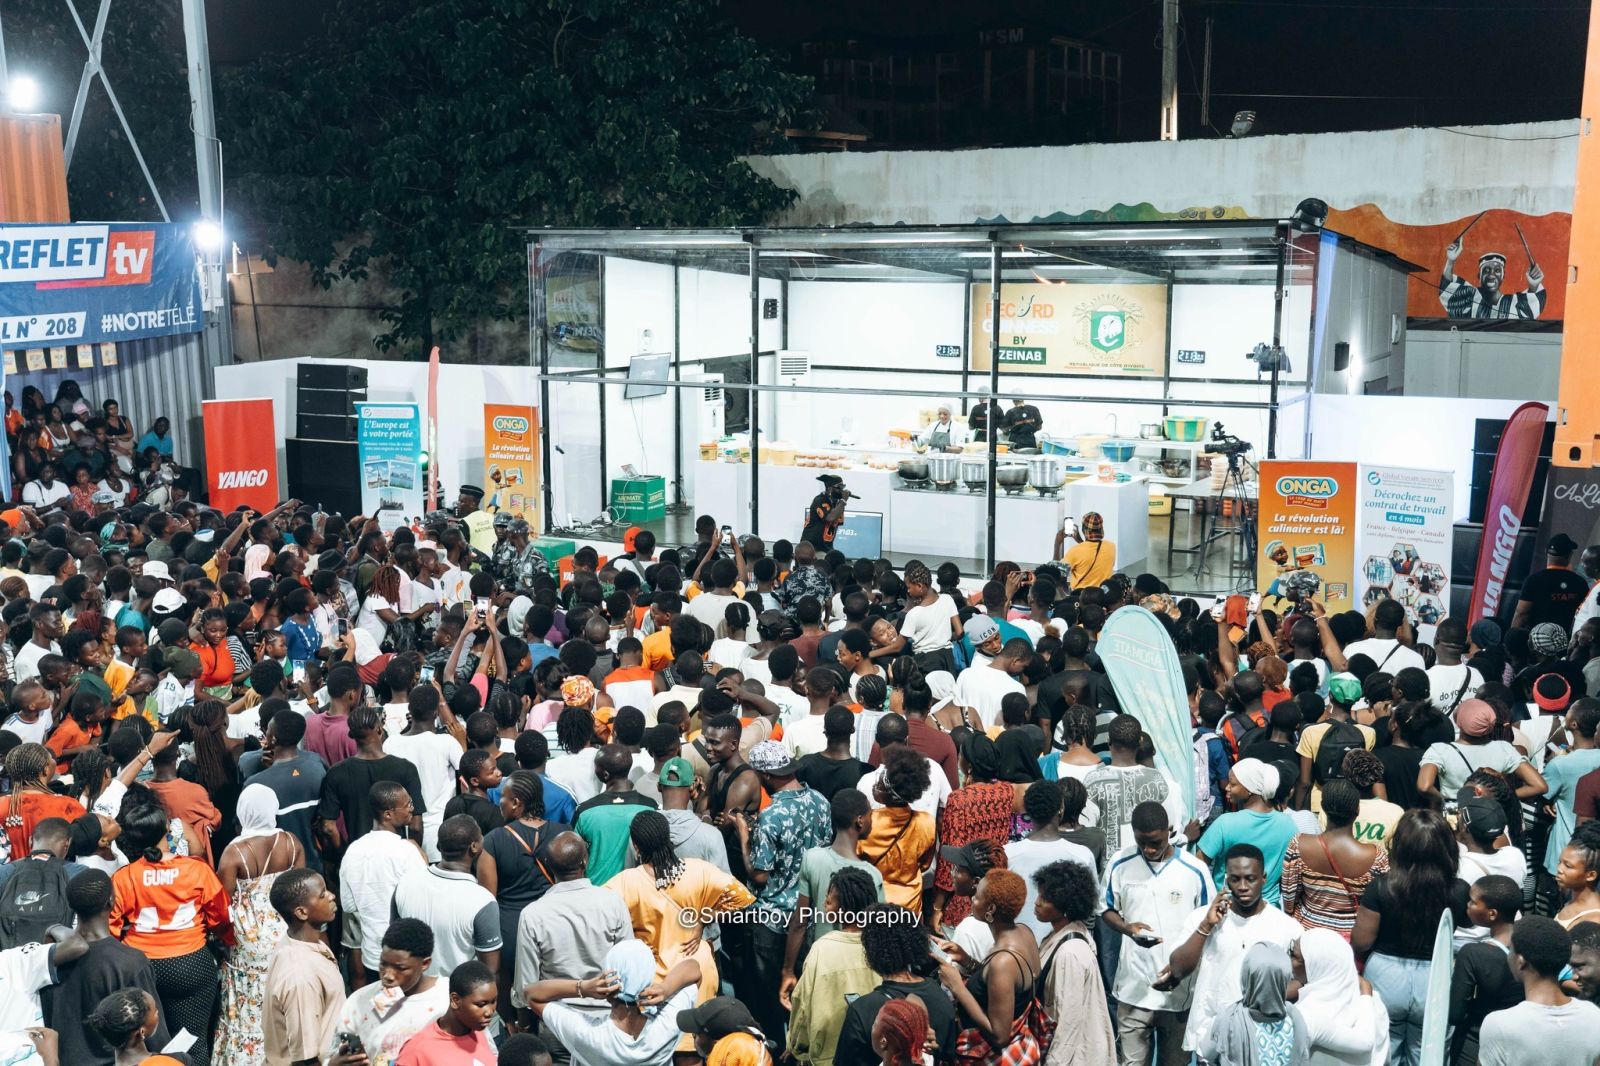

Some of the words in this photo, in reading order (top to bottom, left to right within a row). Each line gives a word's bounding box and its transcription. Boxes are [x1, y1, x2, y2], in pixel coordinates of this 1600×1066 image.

[0, 237, 104, 270] REFLET
[113, 241, 148, 275] tv
[45, 317, 77, 337] 208
[1013, 336, 1027, 345] BY
[998, 349, 1042, 361] ZEINAB
[496, 418, 525, 430] ONGA
[217, 469, 268, 490] YANGO
[1280, 479, 1332, 494] ONGA
[1374, 489, 1421, 502] Décrochez
[1423, 496, 1436, 504] un
[1364, 500, 1397, 510] contrat
[1399, 502, 1411, 511] de
[1413, 506, 1446, 515] travail
[1274, 513, 1286, 522] La
[1288, 513, 1339, 523] révolution
[1404, 516, 1423, 524] mois
[1268, 523, 1311, 533] culinaire
[1314, 525, 1328, 534] est
[1482, 504, 1521, 617] YANGO
[979, 627, 996, 640] ICON
[164, 682, 176, 692] 19
[1440, 691, 1449, 701] do
[1450, 690, 1459, 699] yo
[142, 867, 180, 886] GUMP
